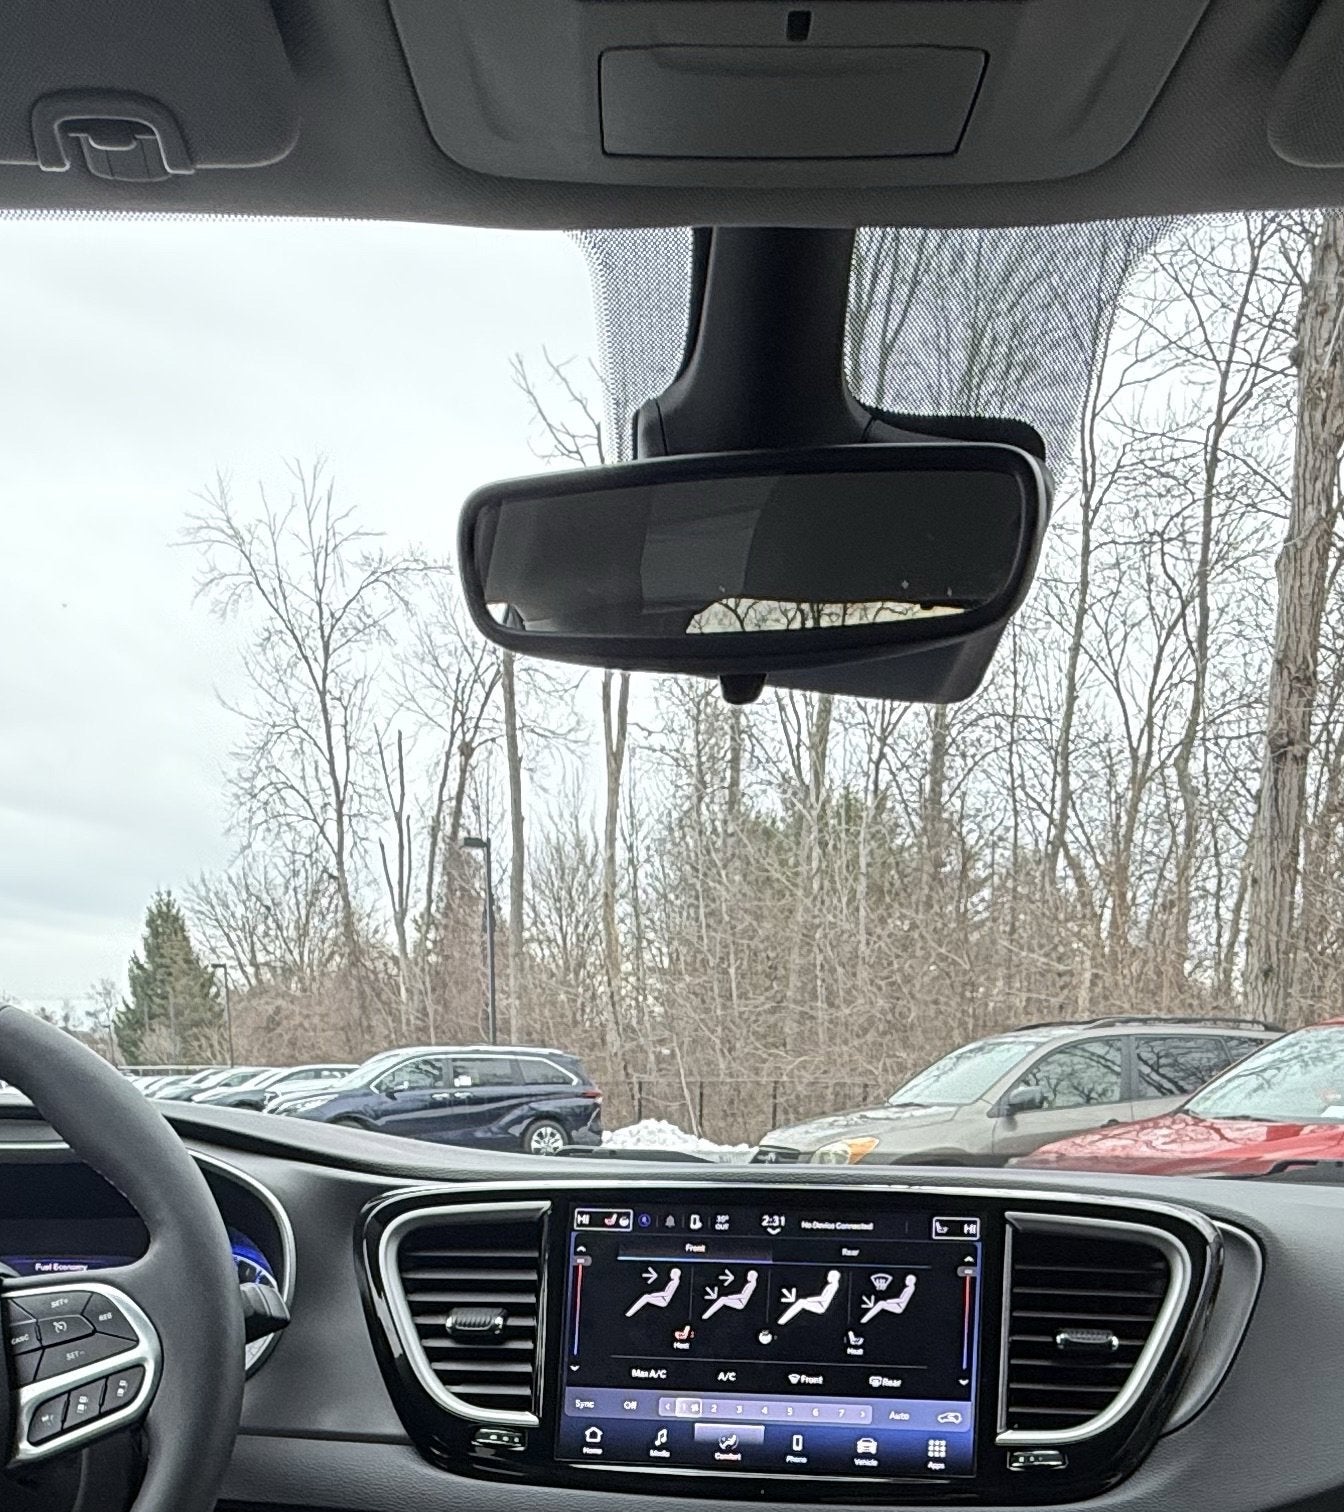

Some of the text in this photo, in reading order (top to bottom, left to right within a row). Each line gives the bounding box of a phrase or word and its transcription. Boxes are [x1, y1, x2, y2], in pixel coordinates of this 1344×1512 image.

[576, 1214, 590, 1225] HI
[761, 1214, 786, 1227] 2:31
[685, 1243, 706, 1253] Front
[841, 1248, 860, 1257] Rear
[35, 1262, 88, 1272] Fuel Economy
[631, 1368, 667, 1379] Max A/C
[717, 1371, 737, 1382] A/C
[800, 1375, 824, 1385] Front
[882, 1378, 902, 1388] Rear
[575, 1399, 595, 1409] Sync
[623, 1400, 638, 1410] Off
[710, 1404, 718, 1413] 2
[736, 1405, 743, 1414] 3
[761, 1406, 768, 1415] 4
[787, 1407, 793, 1416] 5
[812, 1408, 819, 1417] 6
[838, 1409, 845, 1418] 7
[888, 1411, 910, 1421] Auto
[927, 1461, 946, 1471] Apps
